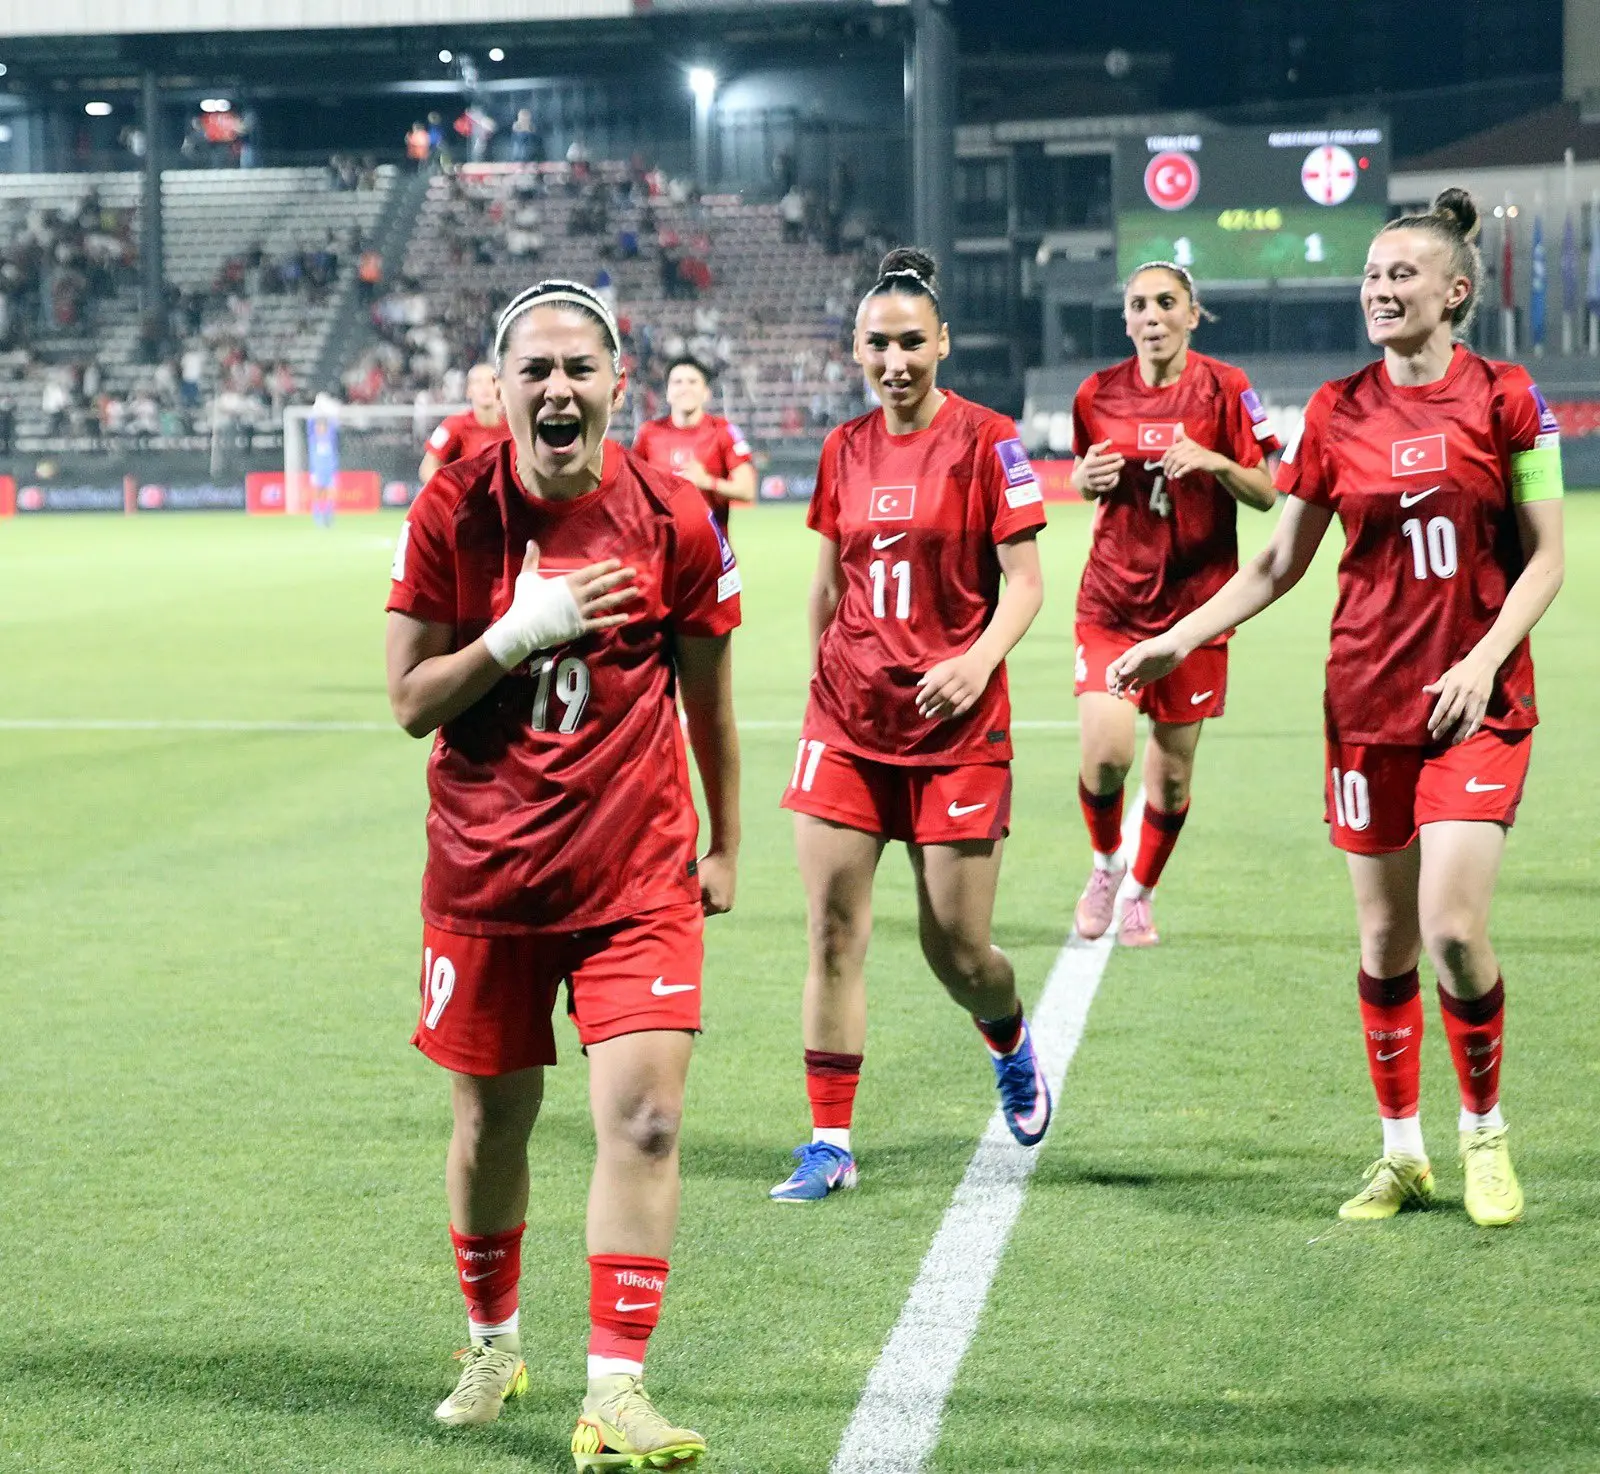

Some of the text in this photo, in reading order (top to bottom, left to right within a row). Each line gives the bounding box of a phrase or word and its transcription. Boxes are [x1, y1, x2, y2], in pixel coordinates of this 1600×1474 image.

[1173, 236, 1194, 266] 1
[1305, 233, 1324, 263] 1
[1149, 474, 1171, 518] 4
[1402, 516, 1458, 580] 10
[869, 560, 911, 620] 11
[528, 655, 591, 734] 19
[791, 738, 826, 792] 11
[1331, 767, 1371, 832] 10
[422, 946, 456, 1031] 19
[457, 1247, 507, 1262] TÜRKİYE
